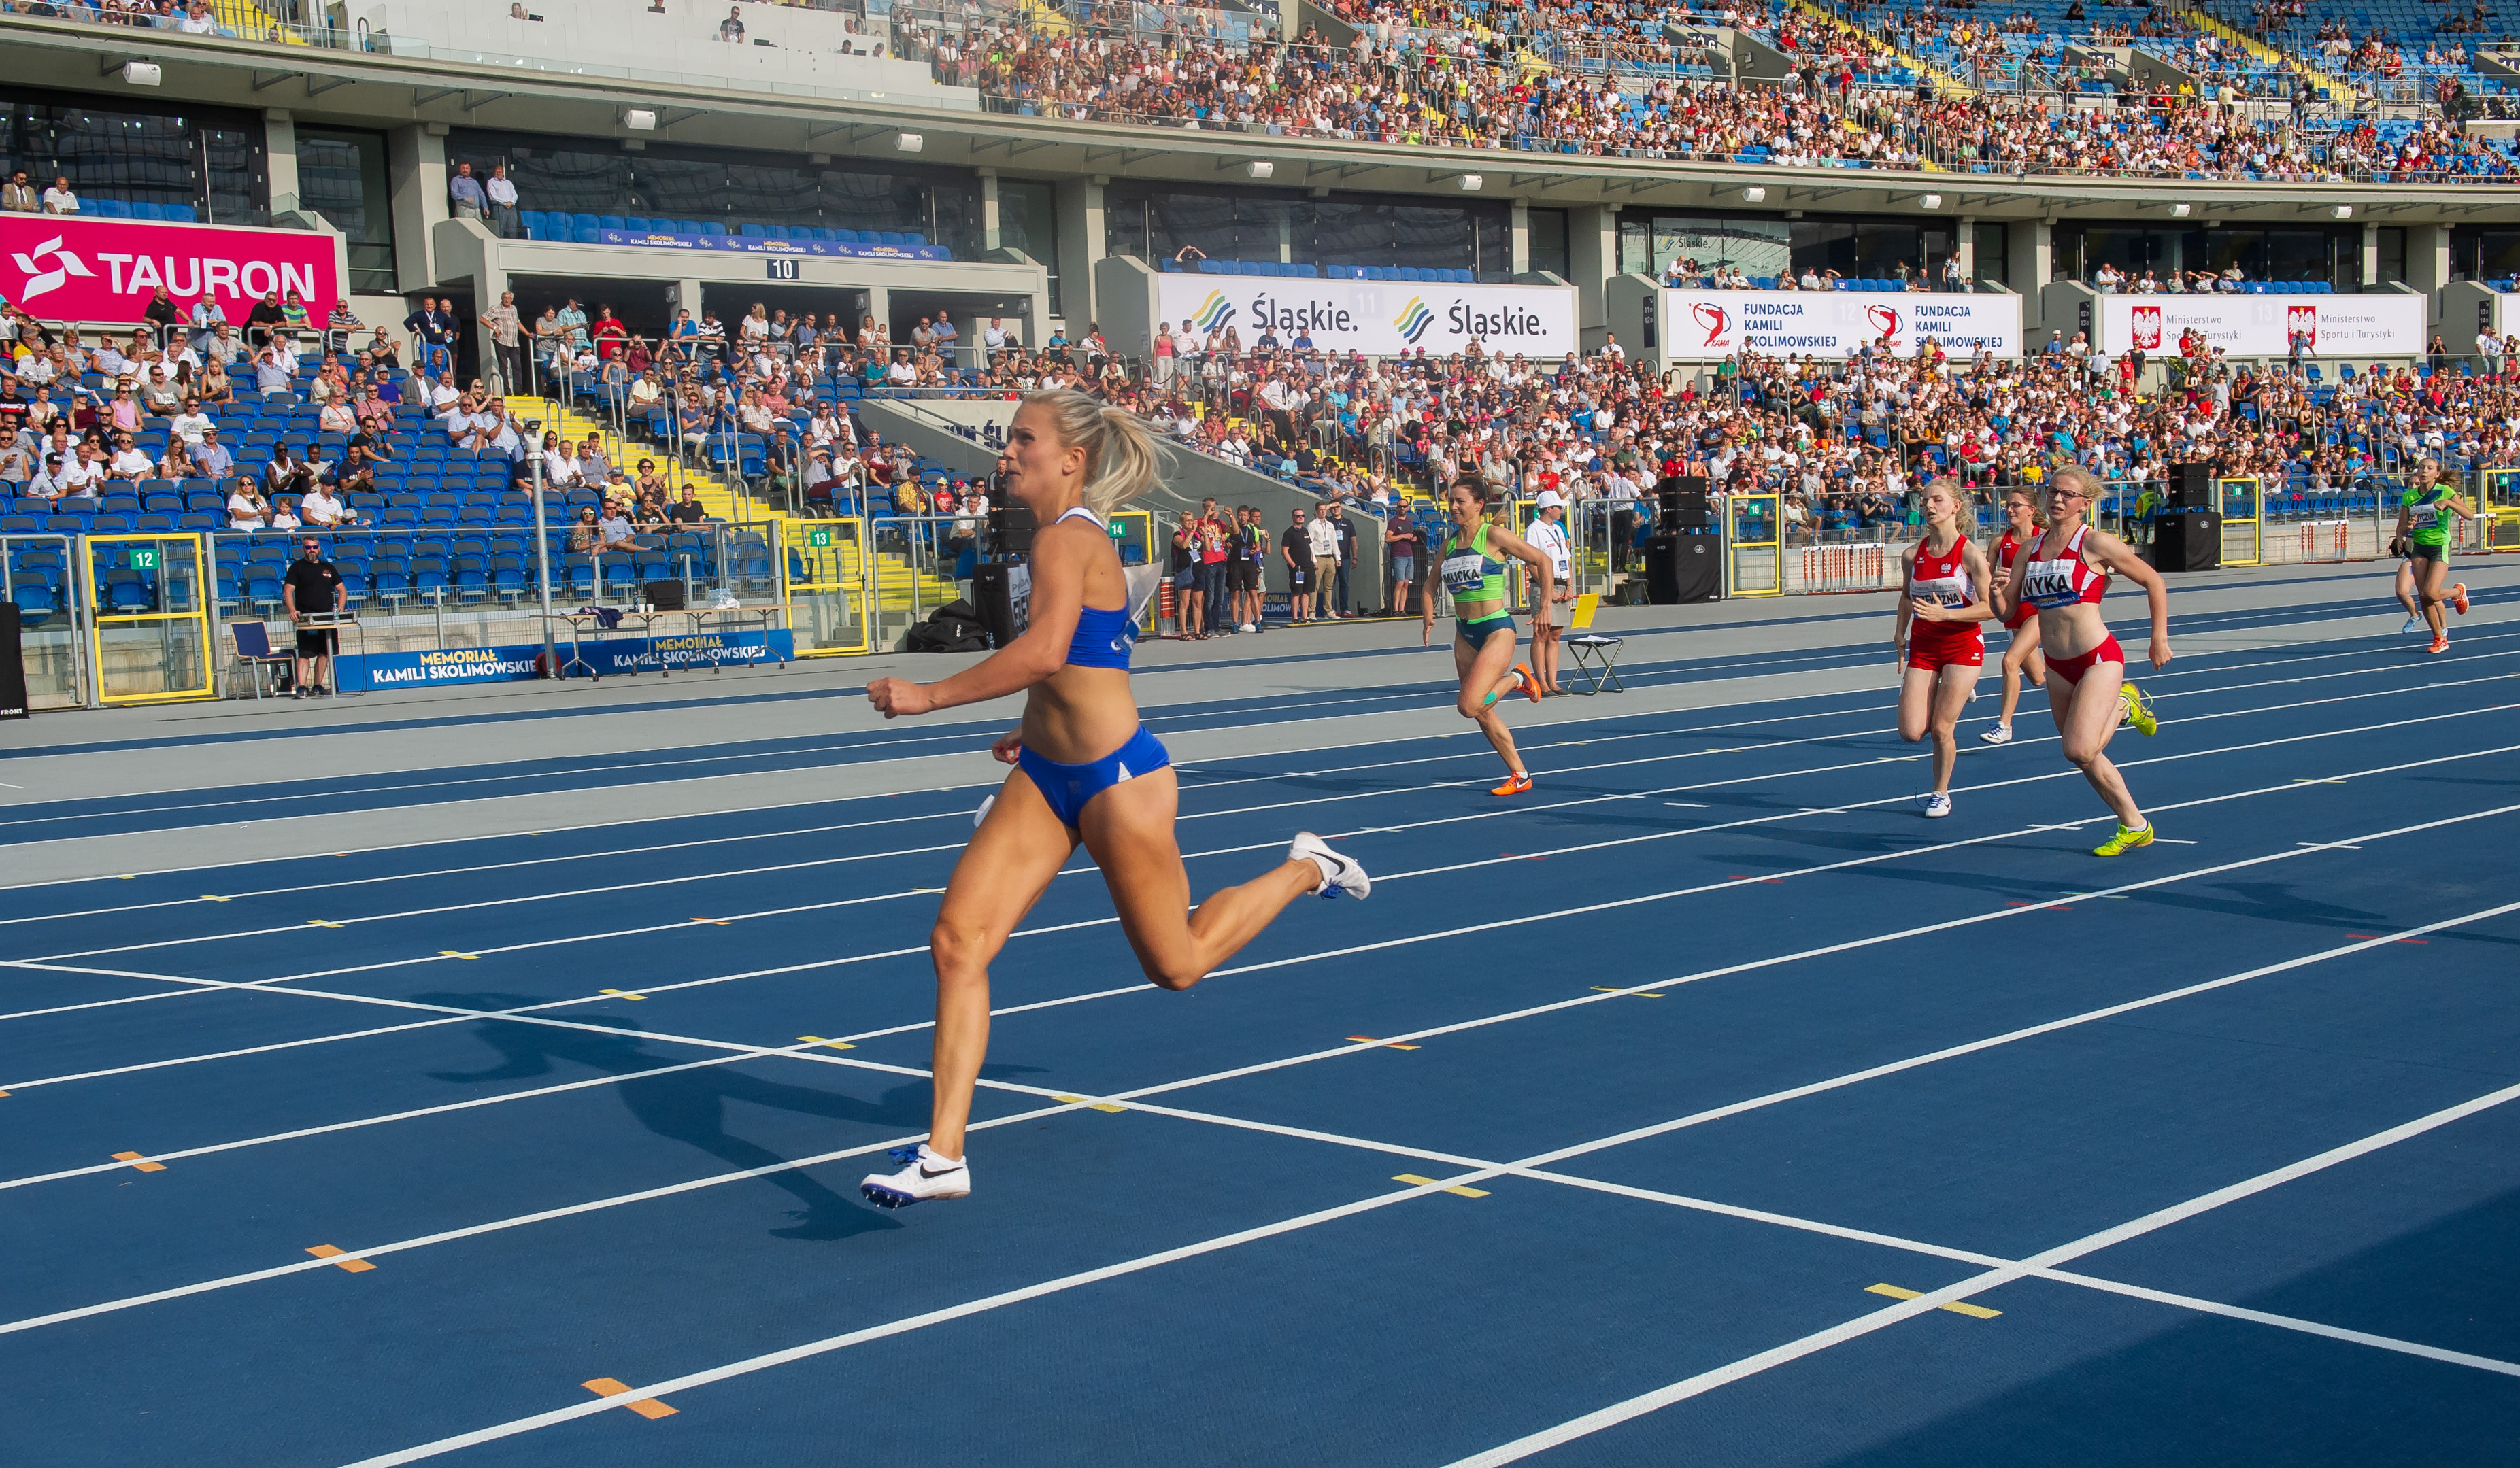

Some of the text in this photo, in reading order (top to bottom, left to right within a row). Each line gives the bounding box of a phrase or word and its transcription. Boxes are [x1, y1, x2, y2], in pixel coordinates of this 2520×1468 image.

[649, 239, 692, 247] SKOLIMOWSKIEJ
[773, 260, 793, 279] 10
[97, 252, 316, 302] TAURON
[1744, 303, 1804, 315] FUNDACJA
[1915, 305, 1971, 317] FUNDACJA
[1251, 292, 1358, 339] Śląskie.
[1449, 298, 1547, 343] Śląskie.
[2166, 315, 2222, 324] Ministerstwo
[2321, 315, 2376, 323] Ministerstwo
[1744, 320, 1783, 331] KAMILI
[1915, 321, 1951, 332] KAMILI
[2204, 330, 2242, 341] Turystyki
[2321, 329, 2395, 341] Sportu i Turystyki
[1751, 336, 1836, 347] KOLIMOWSKIEJ
[1751, 505, 1759, 514] 16
[1111, 524, 1122, 535] 14
[814, 532, 826, 545] 13
[136, 552, 153, 566] 12
[1443, 568, 1480, 584] MUĆKA
[655, 636, 724, 651] MEMORIAŁ
[420, 649, 498, 666] MEMORIAŁ
[614, 645, 765, 667] KAMILI SKOLIMOWSKIEJ
[373, 660, 537, 683] KAMILI SKOLIMOWSKIE
